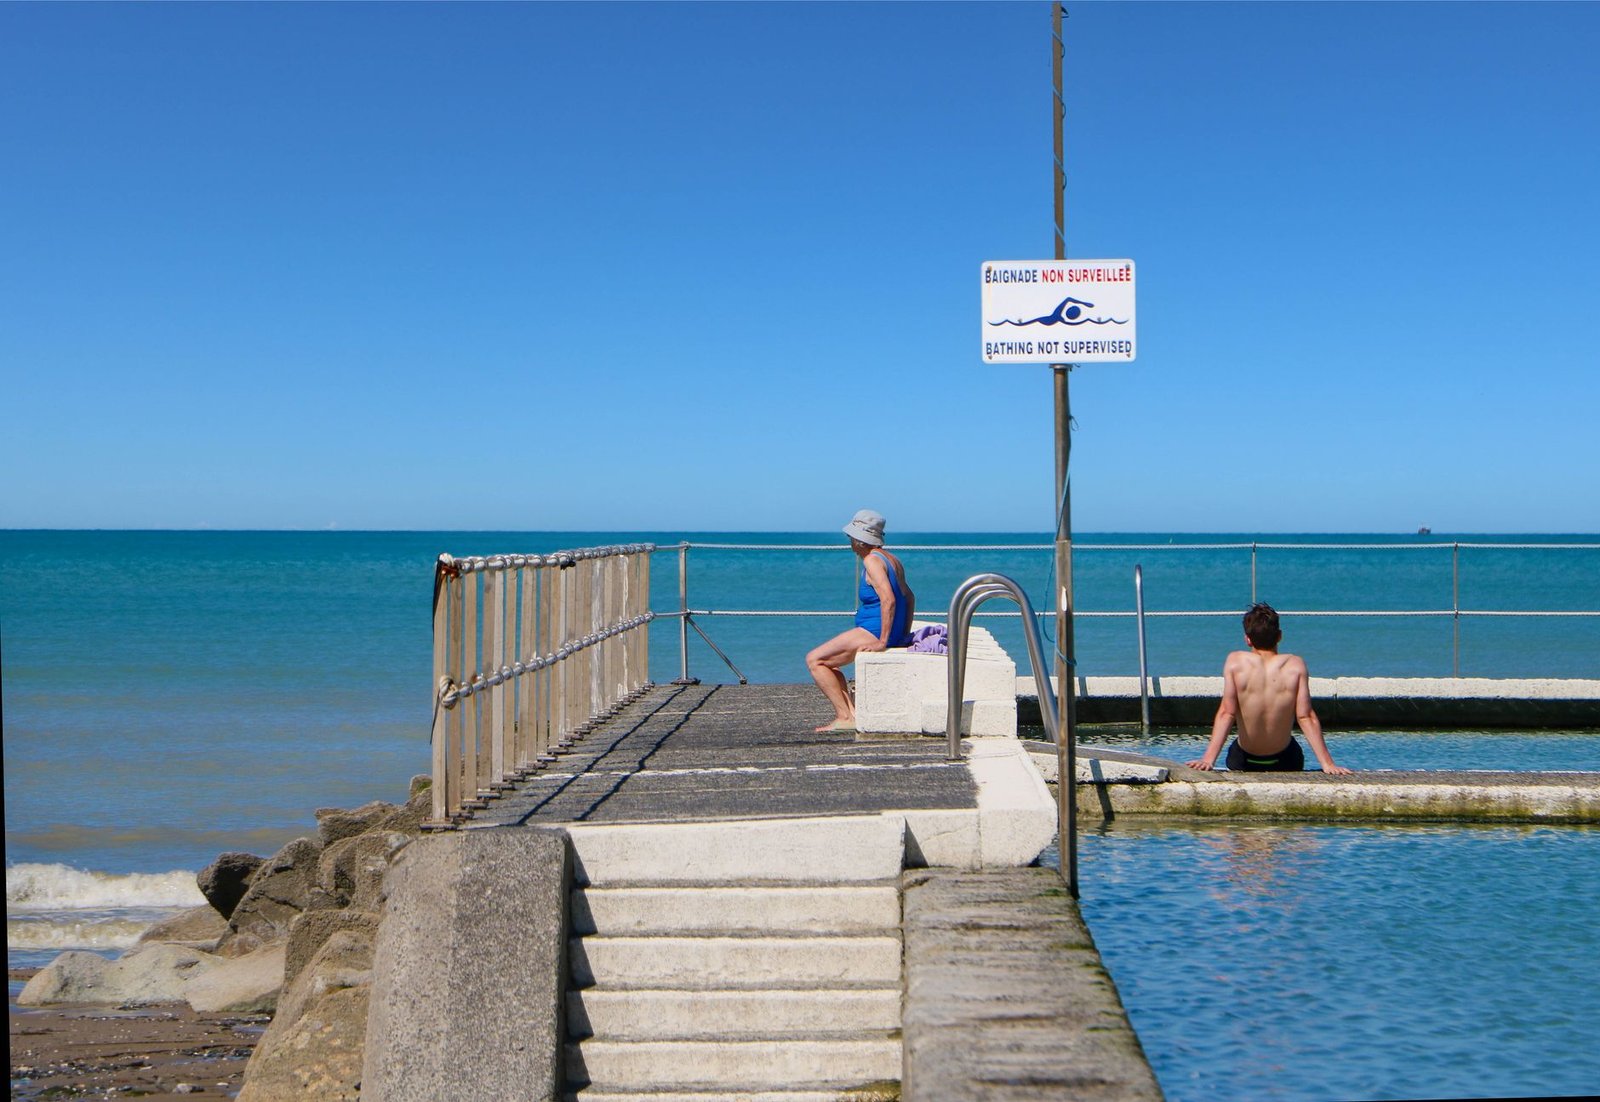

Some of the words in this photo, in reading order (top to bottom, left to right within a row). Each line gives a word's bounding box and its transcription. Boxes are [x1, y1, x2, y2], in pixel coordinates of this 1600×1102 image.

[985, 269, 1037, 284] BAIGNADE
[1042, 269, 1064, 282] NON
[1068, 268, 1131, 282] SURVEILLEE
[986, 342, 1033, 355] BATHING
[1038, 342, 1059, 354] NOT
[1064, 341, 1132, 354] SUPERVISED
